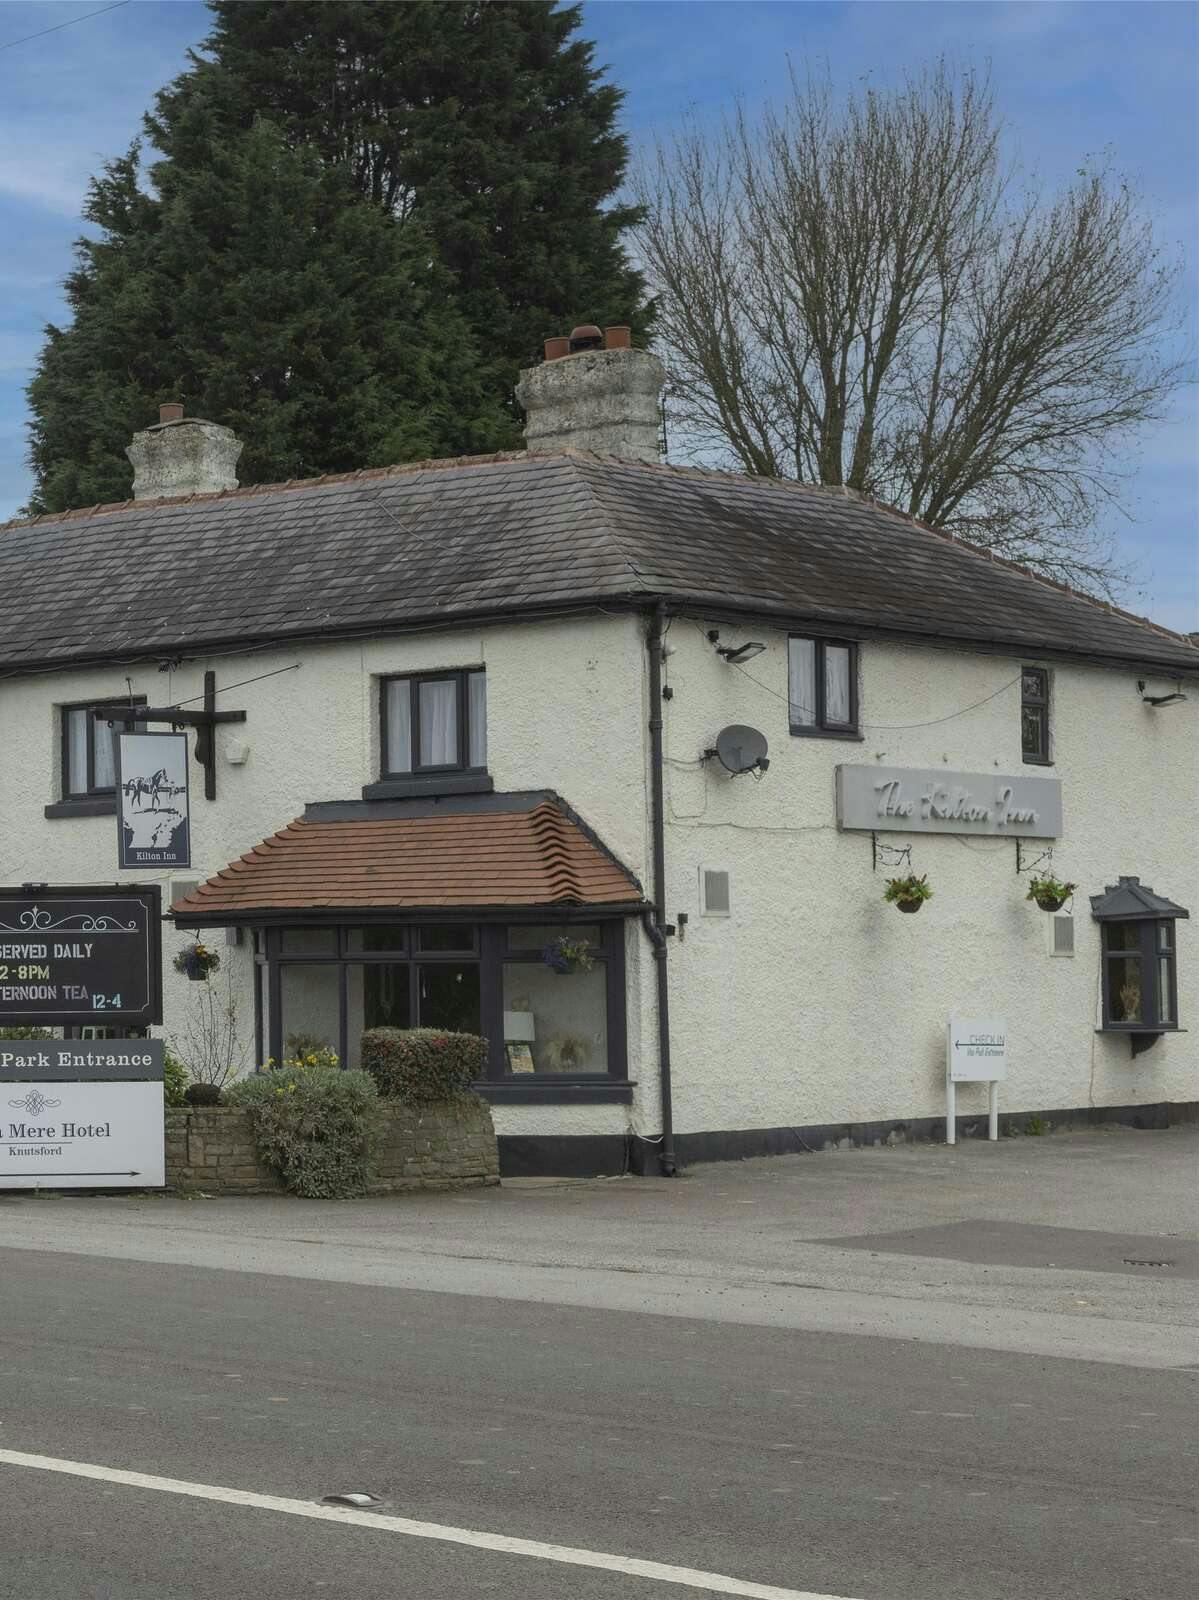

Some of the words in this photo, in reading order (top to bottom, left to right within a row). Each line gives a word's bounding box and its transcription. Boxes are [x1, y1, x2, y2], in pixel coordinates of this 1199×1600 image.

[874, 781, 915, 818] The
[920, 782, 994, 821] Kilton
[995, 785, 1040, 827] Inn
[136, 851, 161, 860] Kilton
[163, 851, 177, 860] Inn
[53, 943, 94, 959] DAILY
[62, 985, 89, 1000] TEA
[92, 993, 123, 1010] 12-4
[1, 1051, 50, 1067] Park
[57, 1050, 153, 1067] Entrance
[8, 1123, 57, 1139] Mere
[61, 1122, 112, 1138] Hotel
[8, 1146, 63, 1157] Knutsford
